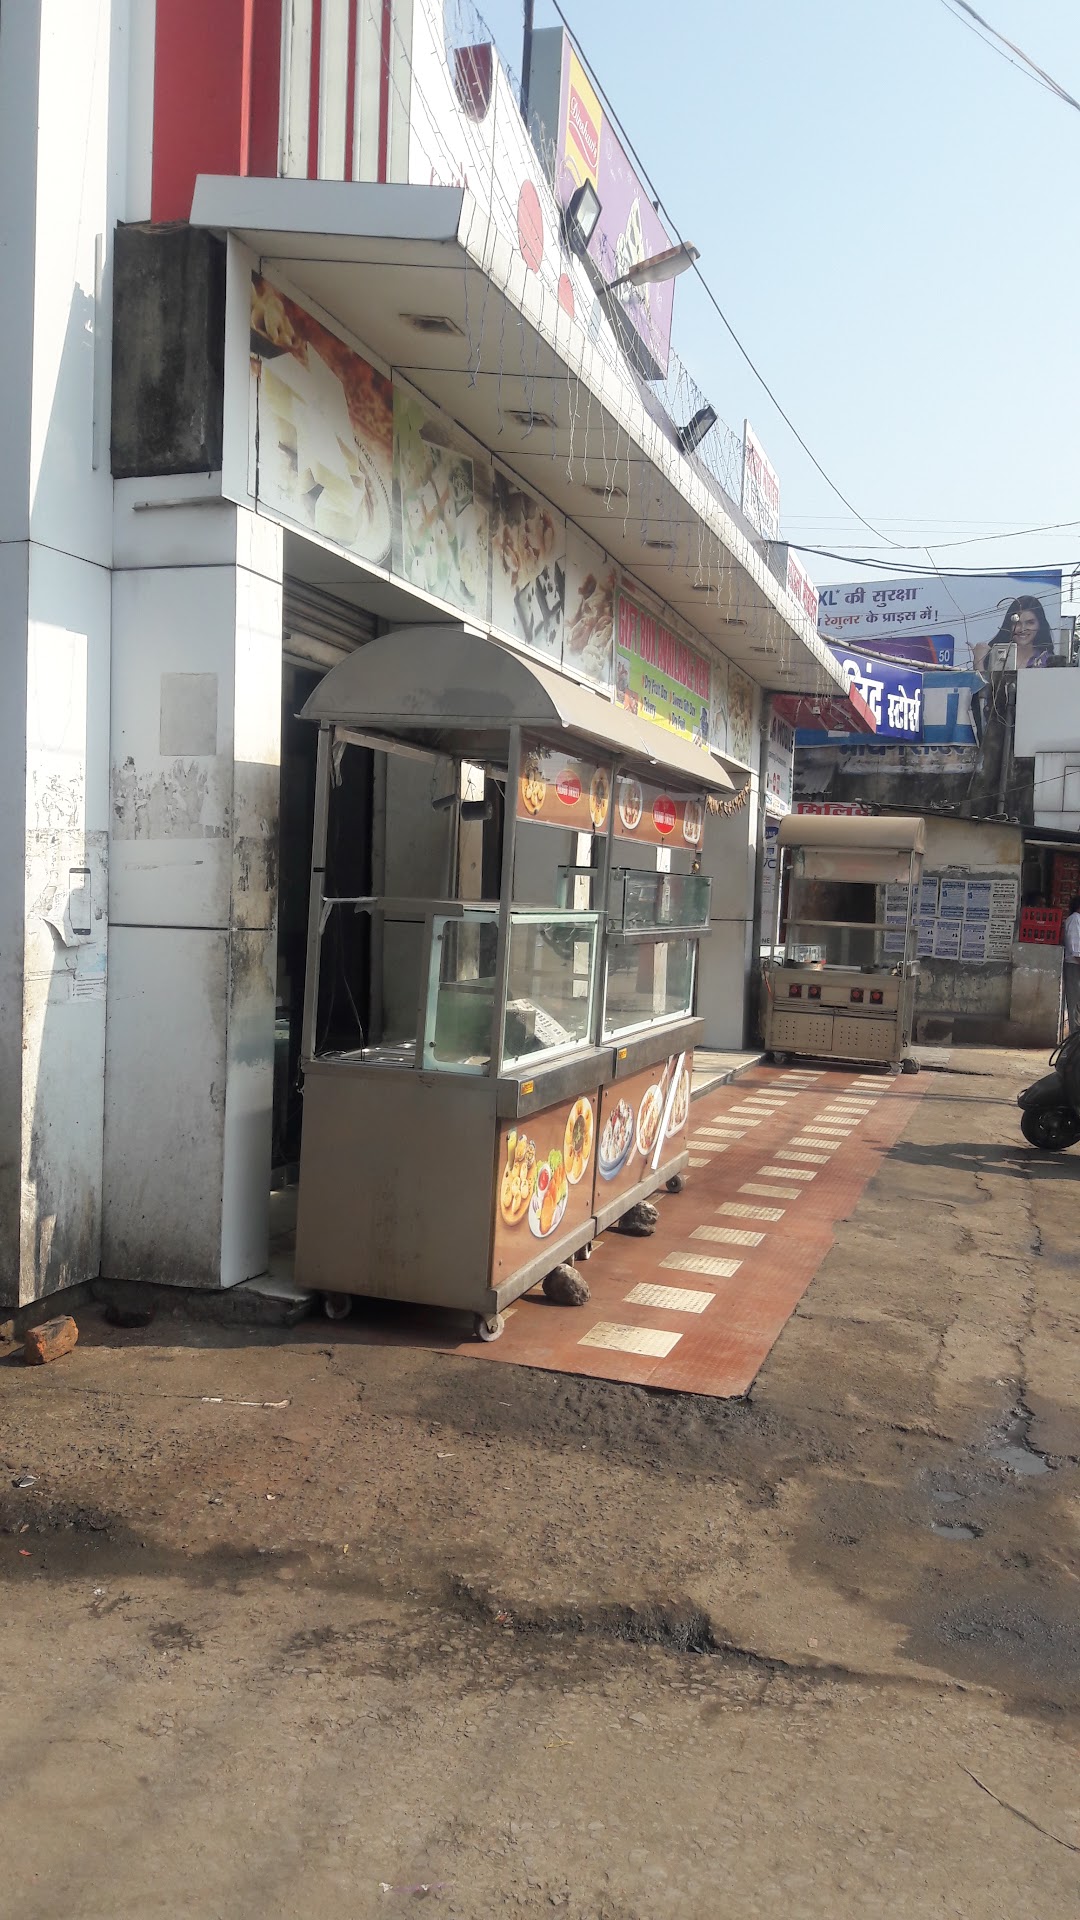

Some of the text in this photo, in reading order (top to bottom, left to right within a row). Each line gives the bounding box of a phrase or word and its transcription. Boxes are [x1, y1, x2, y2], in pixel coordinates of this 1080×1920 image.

[845, 587, 866, 604] की
[824, 614, 860, 629] रेगुलर
[865, 611, 879, 623] के
[883, 611, 917, 624] प्राइस
[618, 593, 639, 655] GIFT
[640, 610, 657, 668] BOX
[938, 650, 950, 662] 50
[887, 684, 921, 733] स्टोर्स
